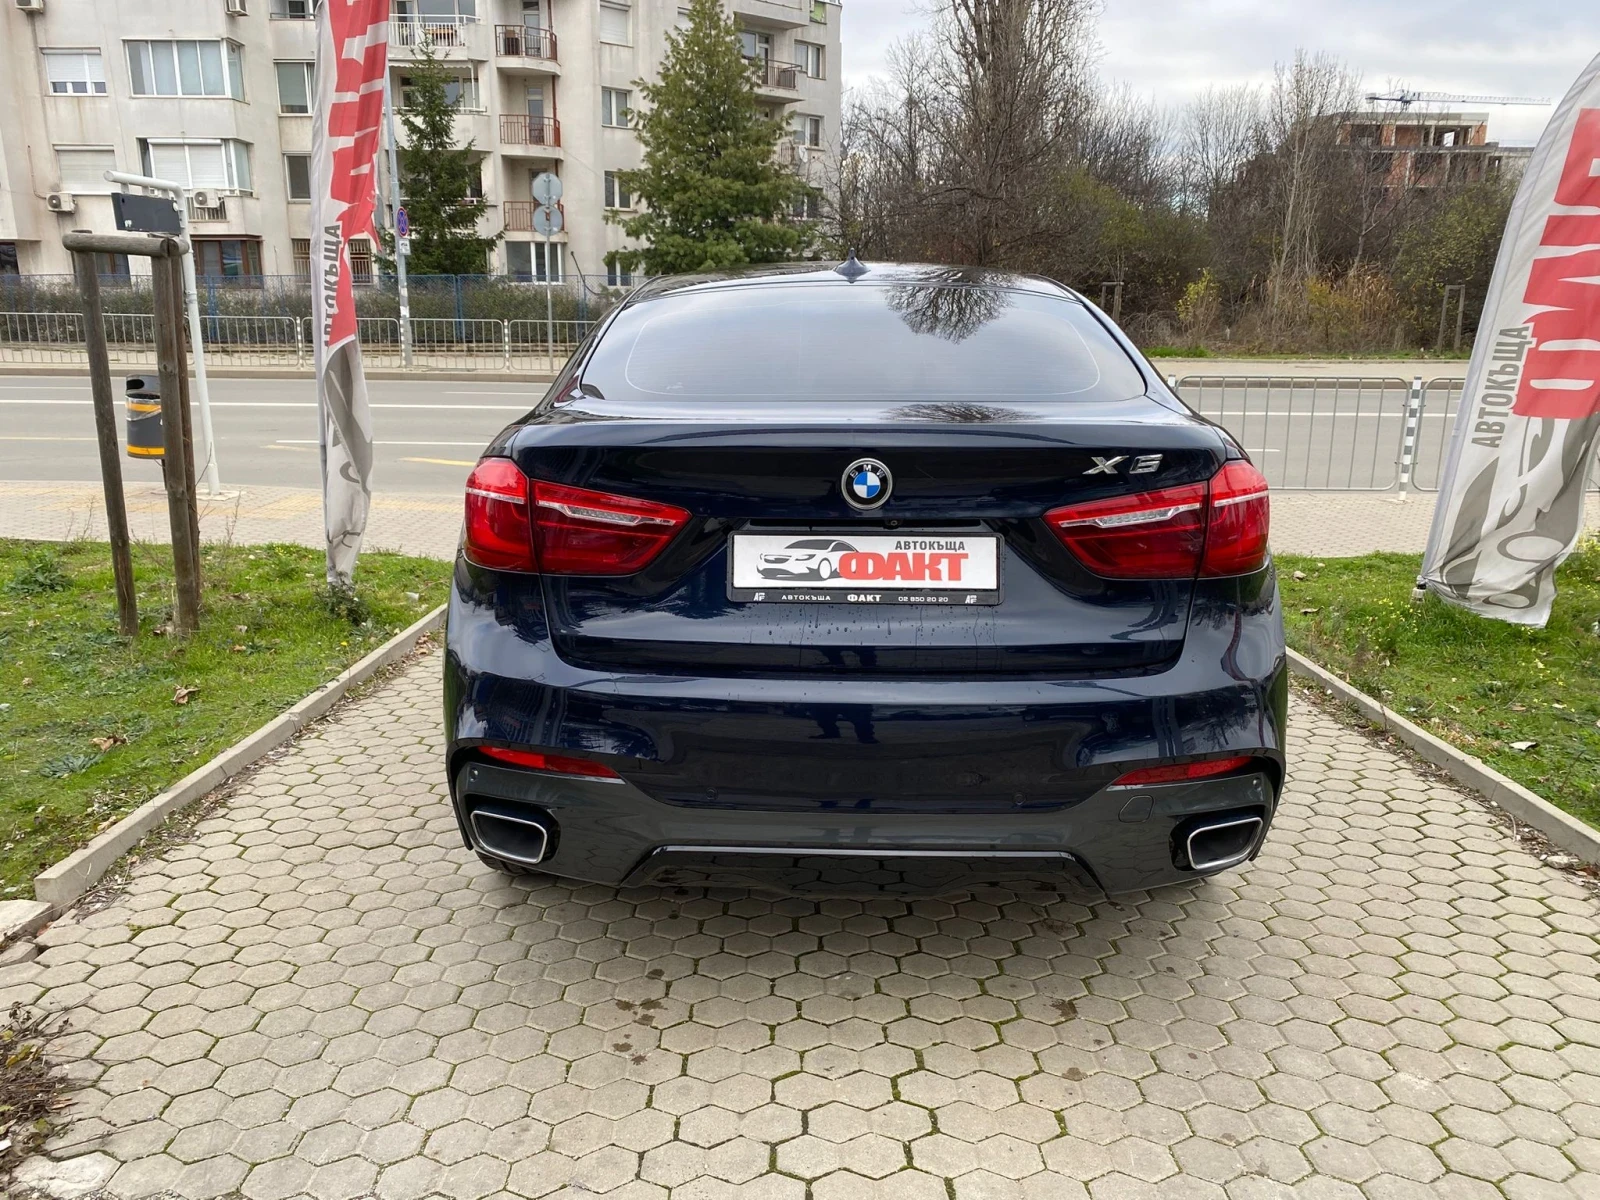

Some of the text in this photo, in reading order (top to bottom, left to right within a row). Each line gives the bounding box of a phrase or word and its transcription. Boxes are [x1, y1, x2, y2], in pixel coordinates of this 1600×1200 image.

[1471, 326, 1533, 448] АВТОКЪЩА
[850, 464, 885, 479] BMW
[895, 540, 966, 552] АВТОКЪЩА
[838, 552, 969, 581] ФАКТ
[847, 594, 882, 602] ФАКТ
